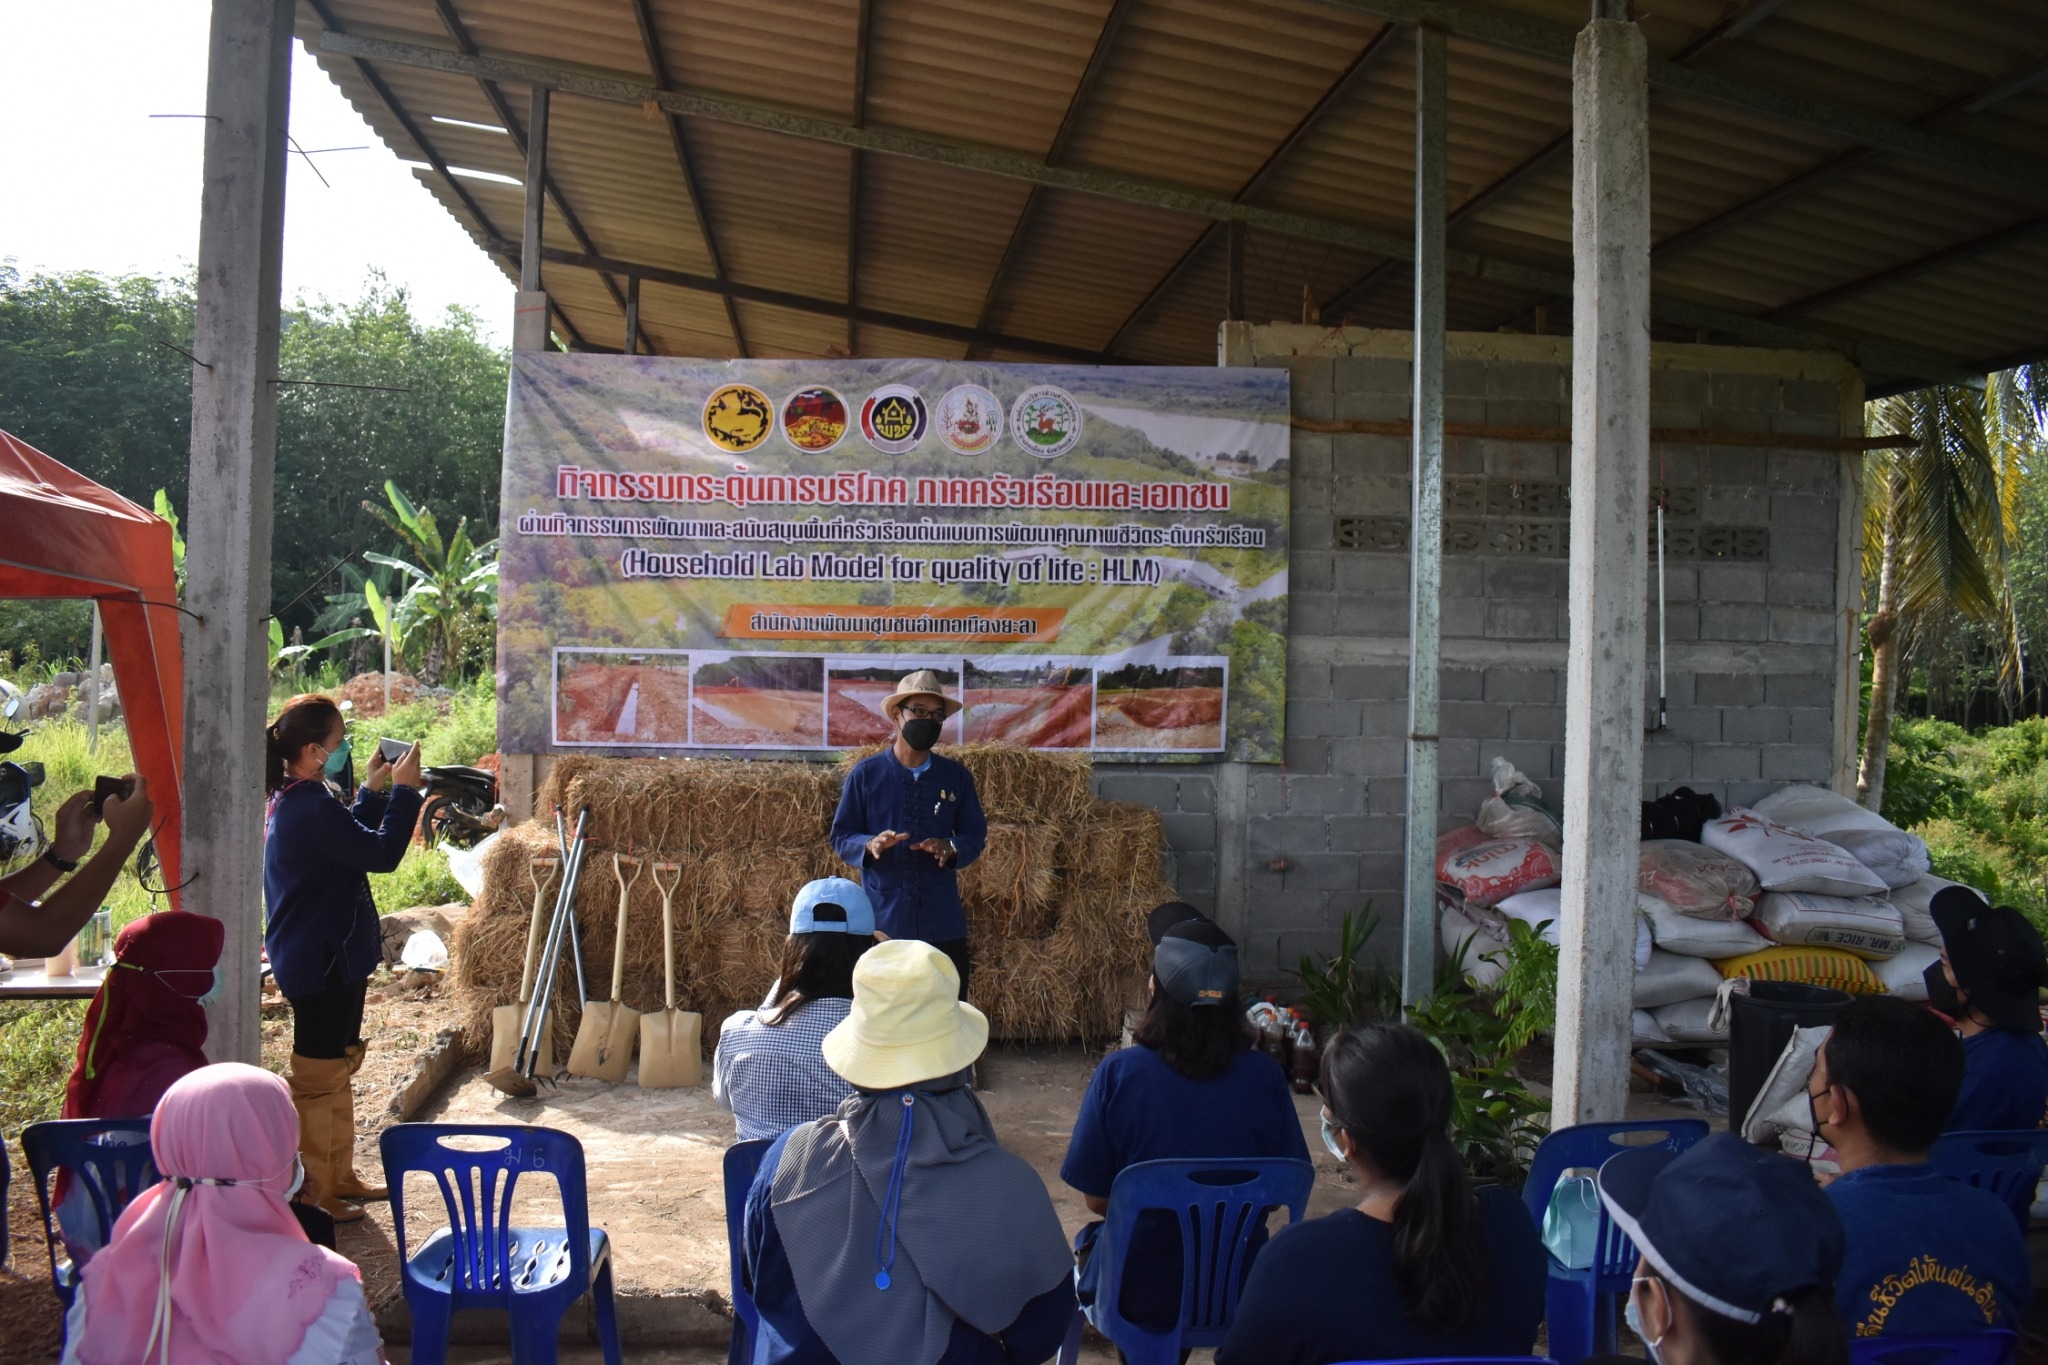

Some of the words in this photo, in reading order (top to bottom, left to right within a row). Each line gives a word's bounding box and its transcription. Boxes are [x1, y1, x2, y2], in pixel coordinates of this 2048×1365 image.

[559, 465, 906, 506] กิจกรรมกระตุ้นการบริโภค
[917, 475, 1229, 508] ภาคครัวเรือนและเอกชน
[519, 511, 1265, 547] ผ่านกิจกรรมการพัฒนาและสนับสนุนพื้นที่ครัวเรือนต้นแบบการพัฒนาคุณภาพชีวิตระดับครัวเรือน
[622, 551, 754, 577] (Household
[761, 553, 804, 577] Lab
[812, 554, 884, 579] Model
[892, 557, 924, 581] for
[931, 557, 1013, 585] quality
[1018, 557, 1046, 581] of
[1048, 557, 1084, 581] life
[1089, 562, 1096, 581] :
[1103, 559, 1161, 586] HLM)
[750, 613, 1038, 637] สำนักงานพัฒนาชุมชนอำเภอเมืองยะลา
[1835, 932, 1865, 946] RICE
[1869, 936, 1890, 950] MR.
